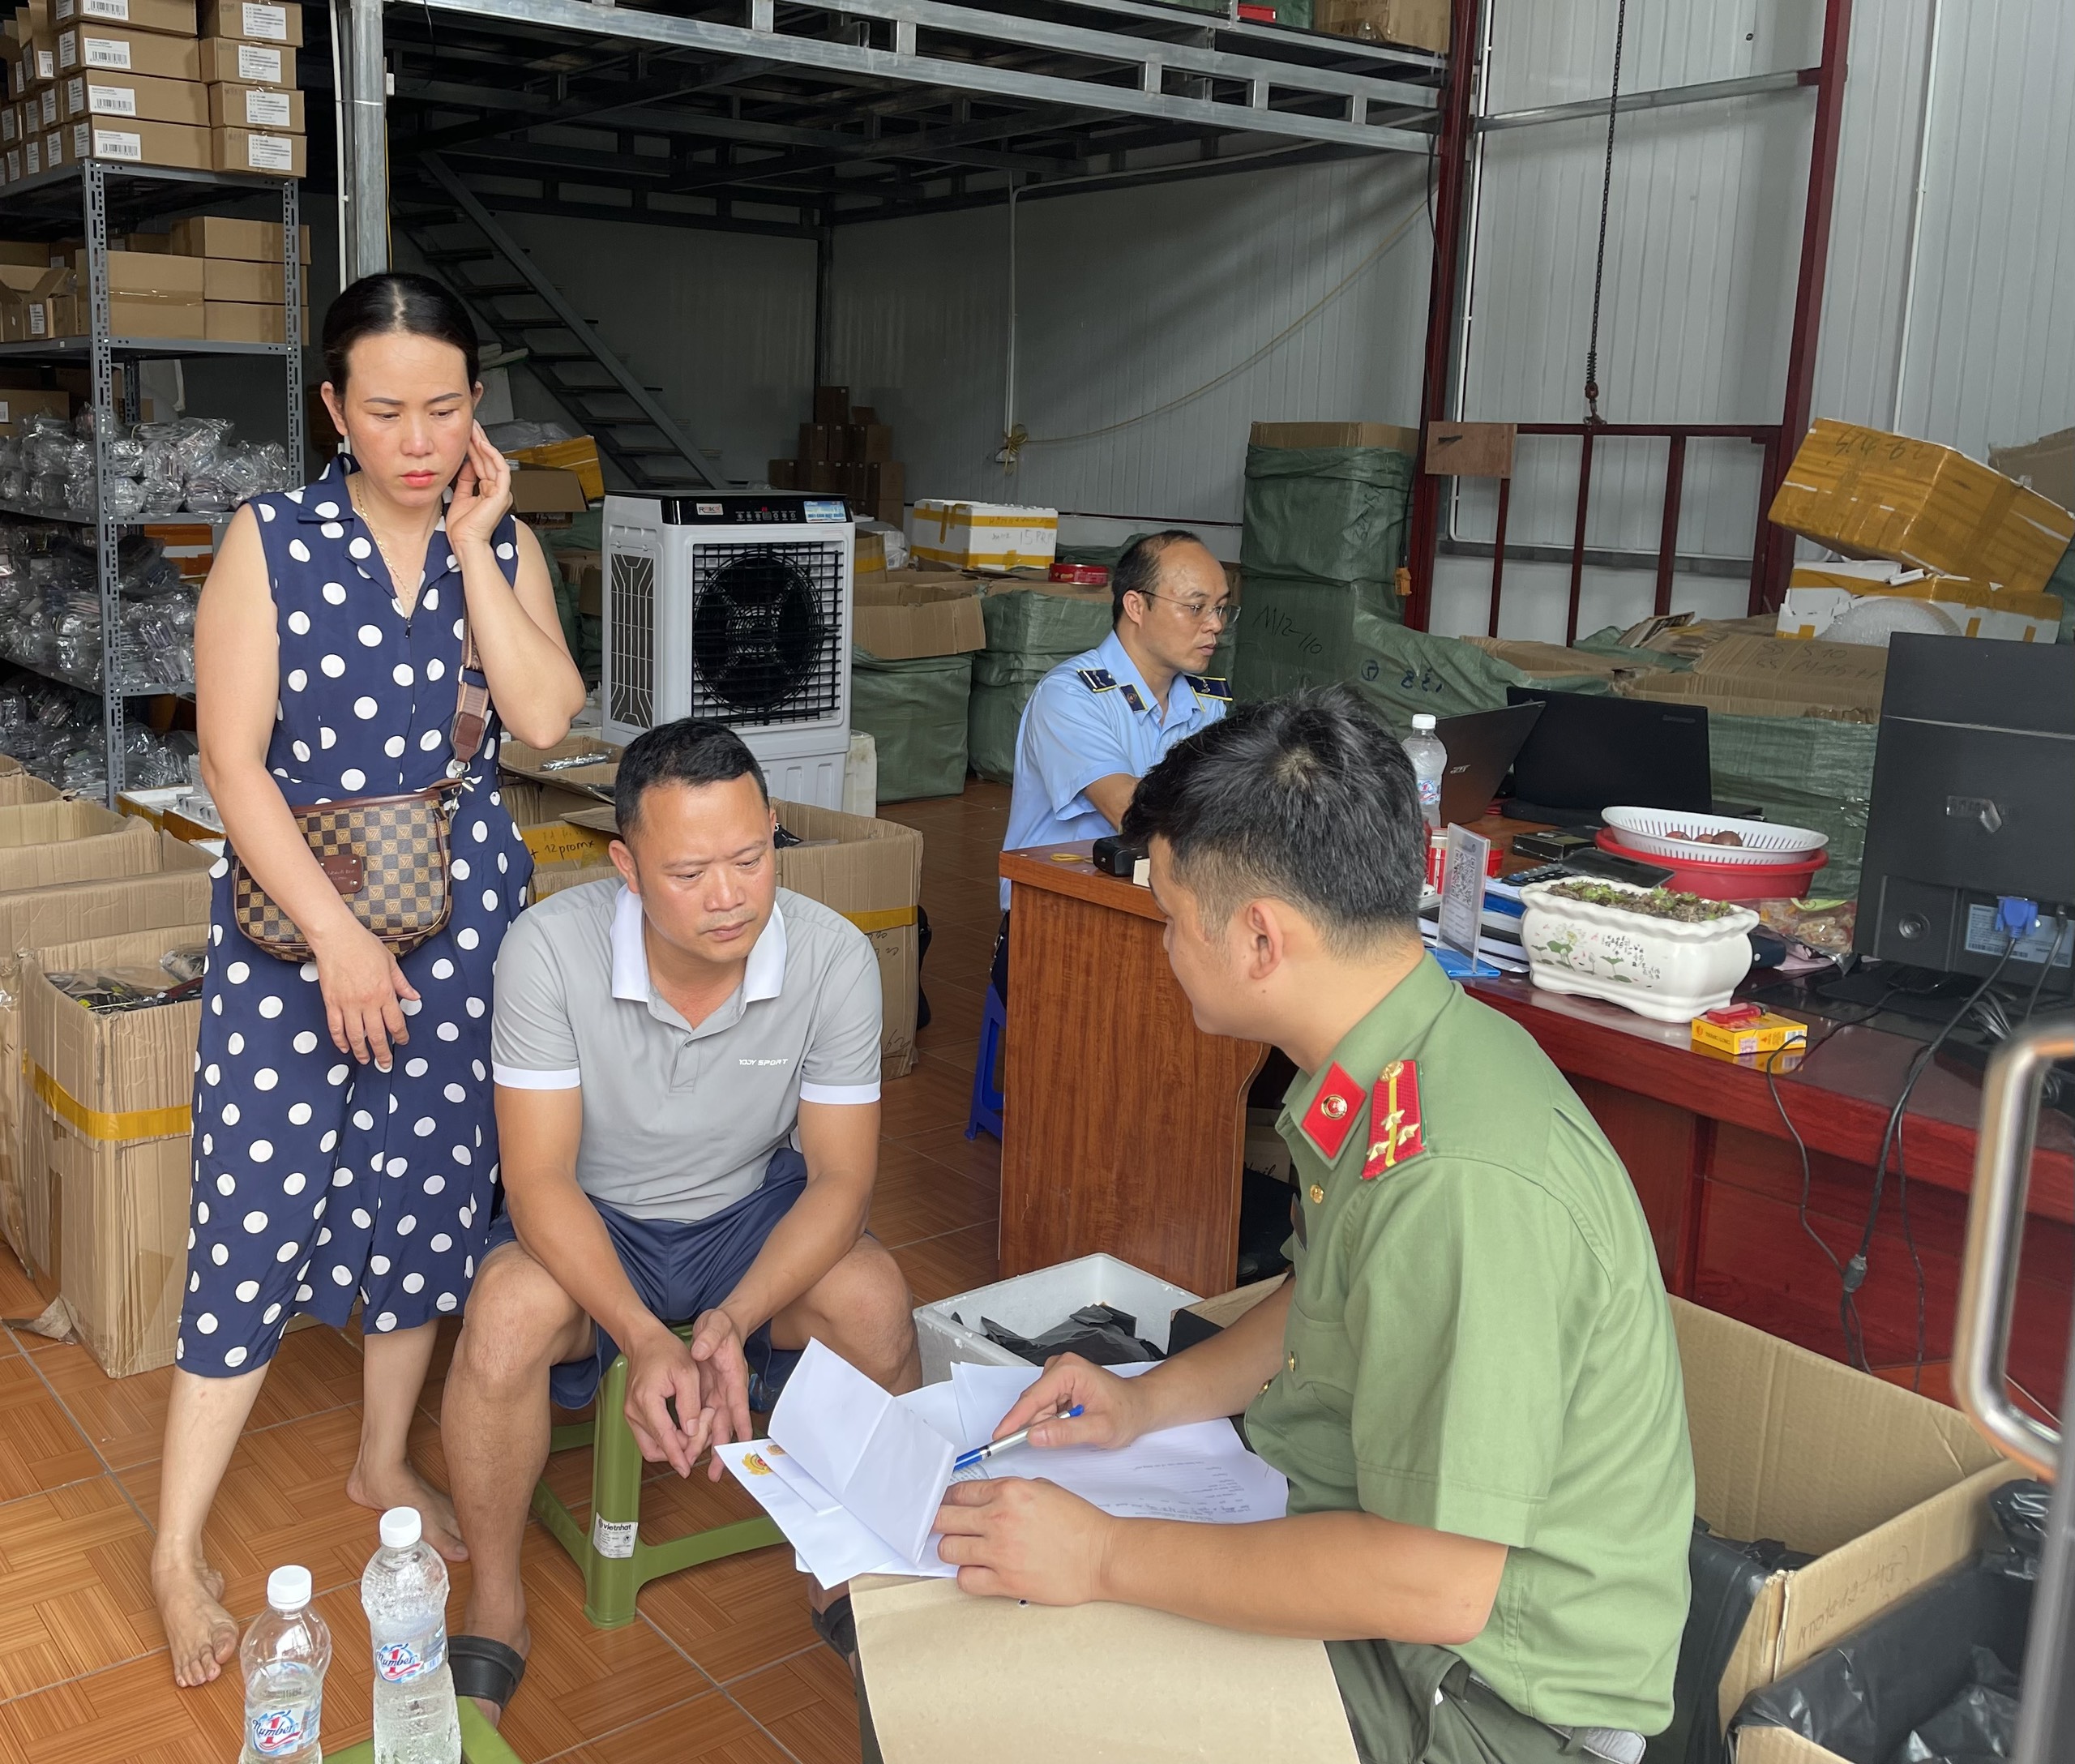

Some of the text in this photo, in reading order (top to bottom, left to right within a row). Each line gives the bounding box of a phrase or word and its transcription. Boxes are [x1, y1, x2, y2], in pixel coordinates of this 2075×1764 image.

[757, 1058, 789, 1066] SPORT
[376, 1651, 417, 1668] Number
[252, 1719, 298, 1738] Number
